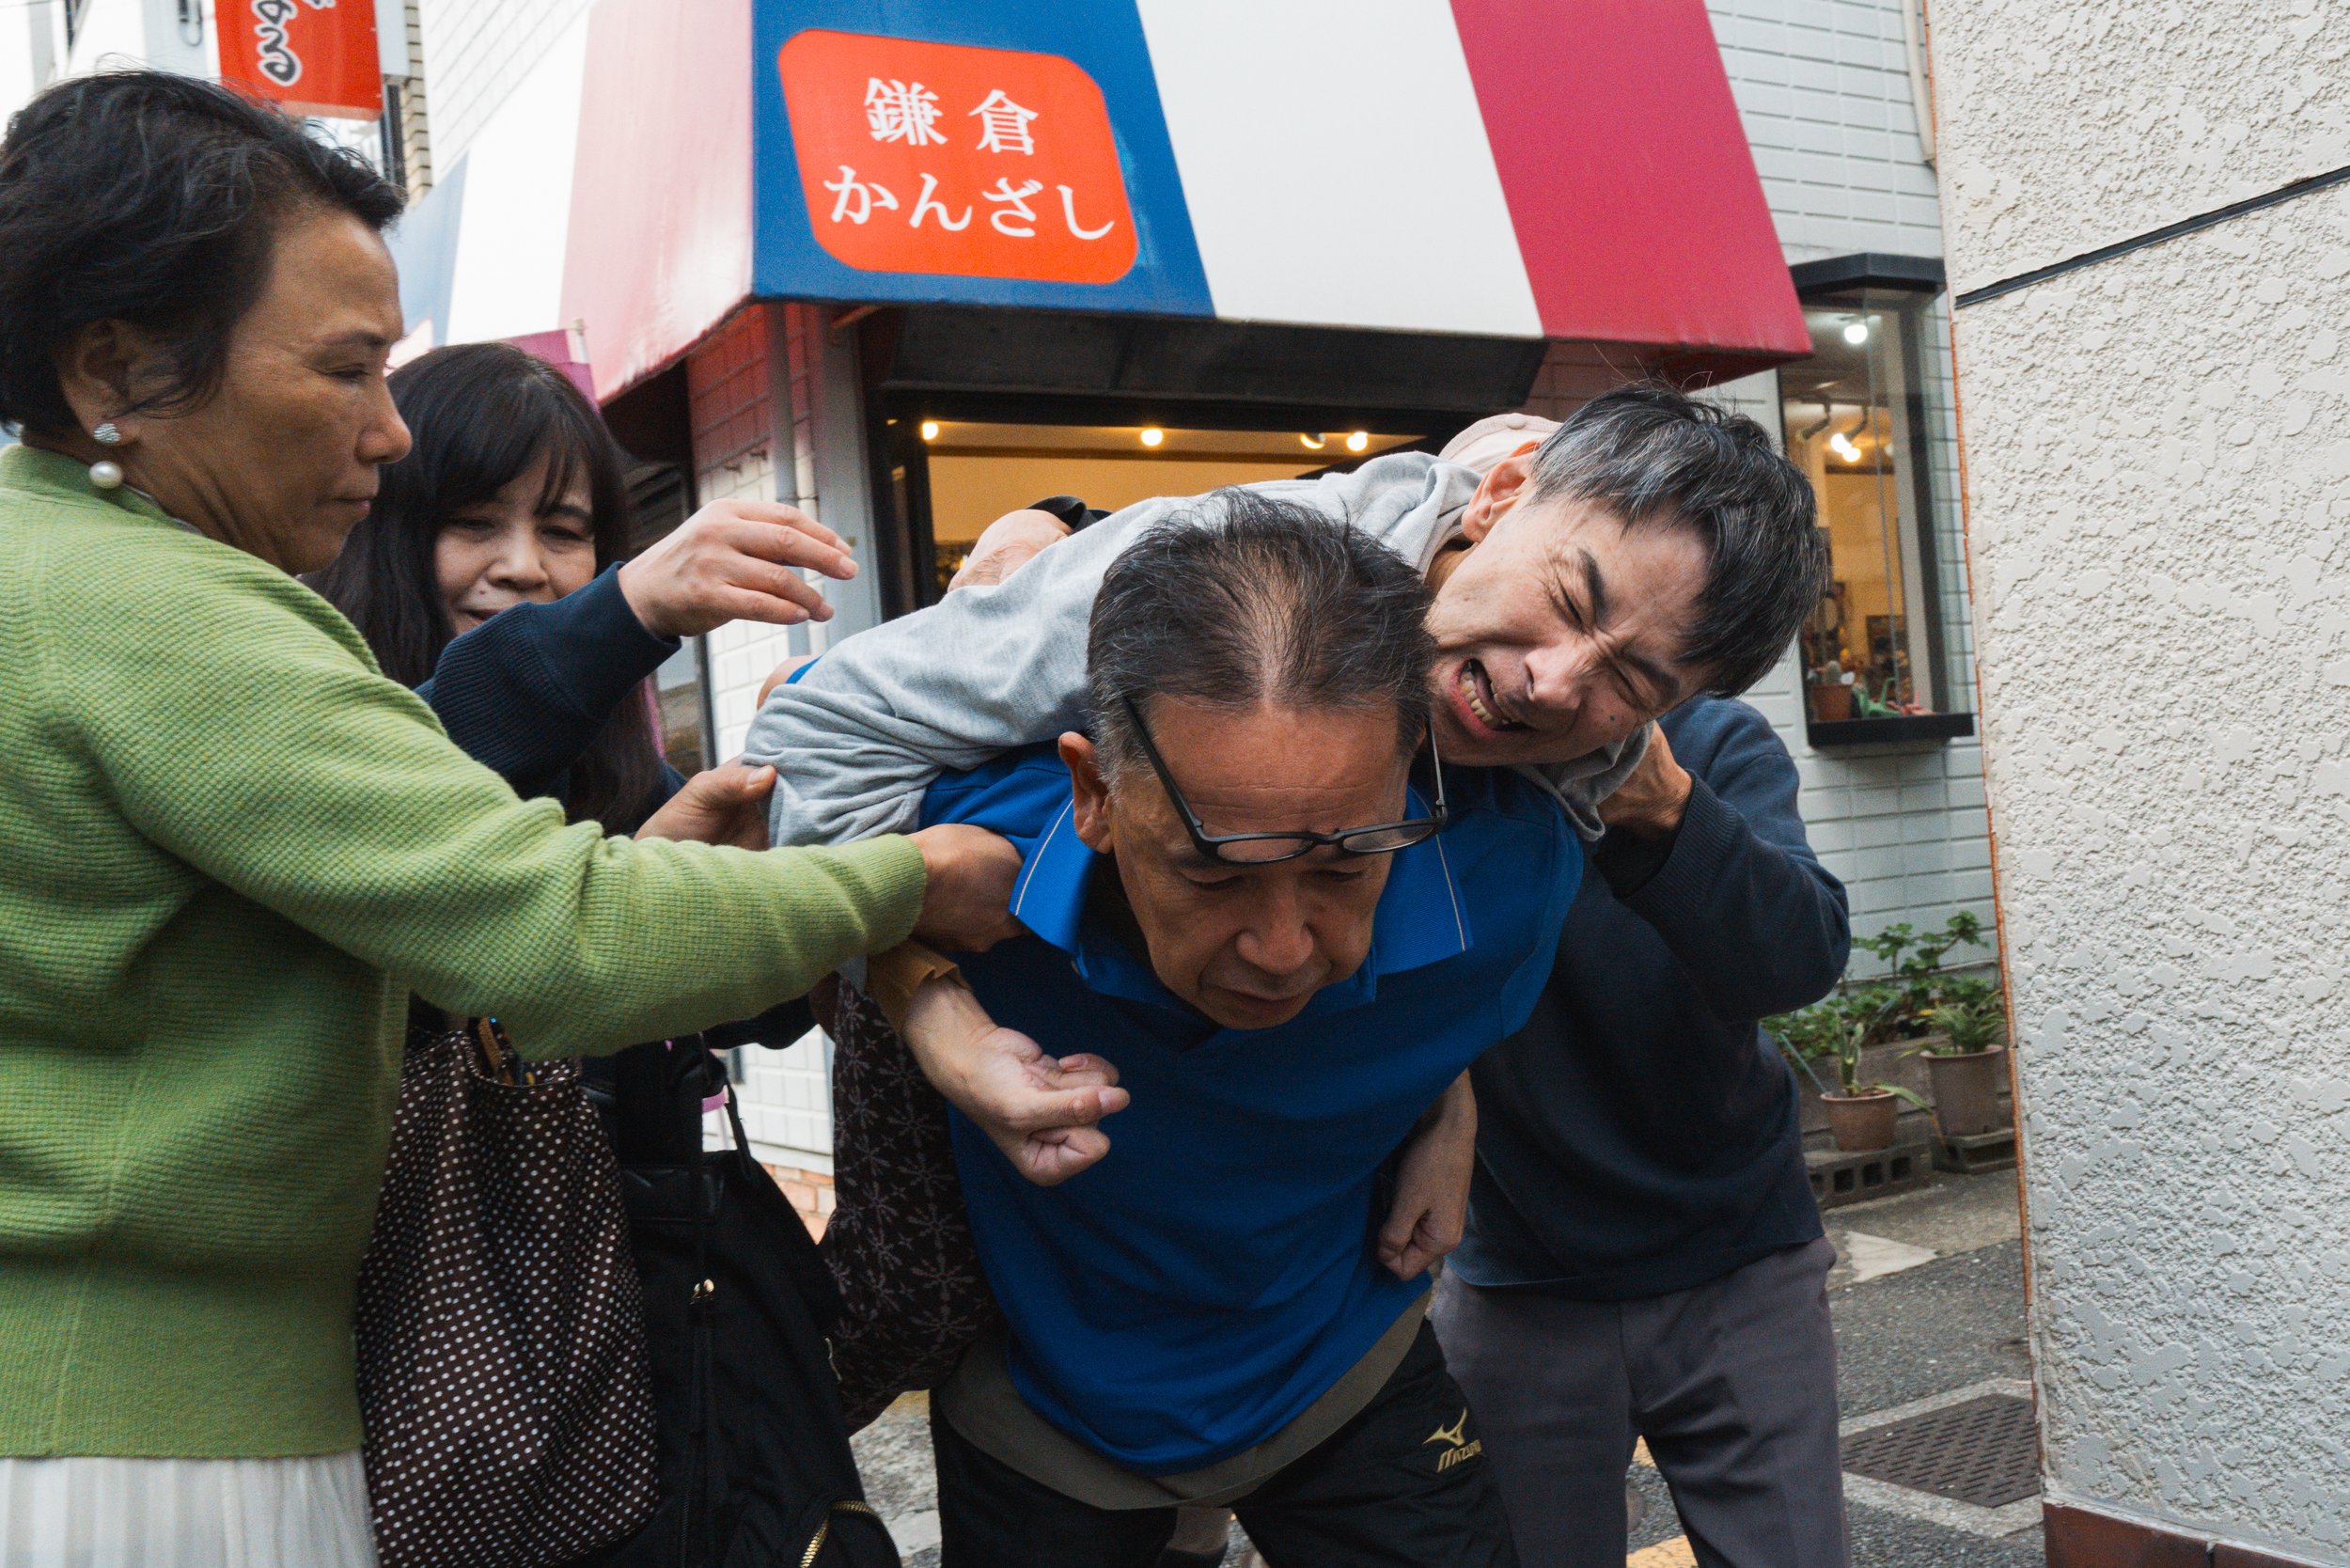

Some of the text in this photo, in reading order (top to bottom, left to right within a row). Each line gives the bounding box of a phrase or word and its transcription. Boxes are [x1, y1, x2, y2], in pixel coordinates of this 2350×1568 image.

[864, 77, 1039, 156] 鎌倉
[822, 165, 1116, 241] かんざし
